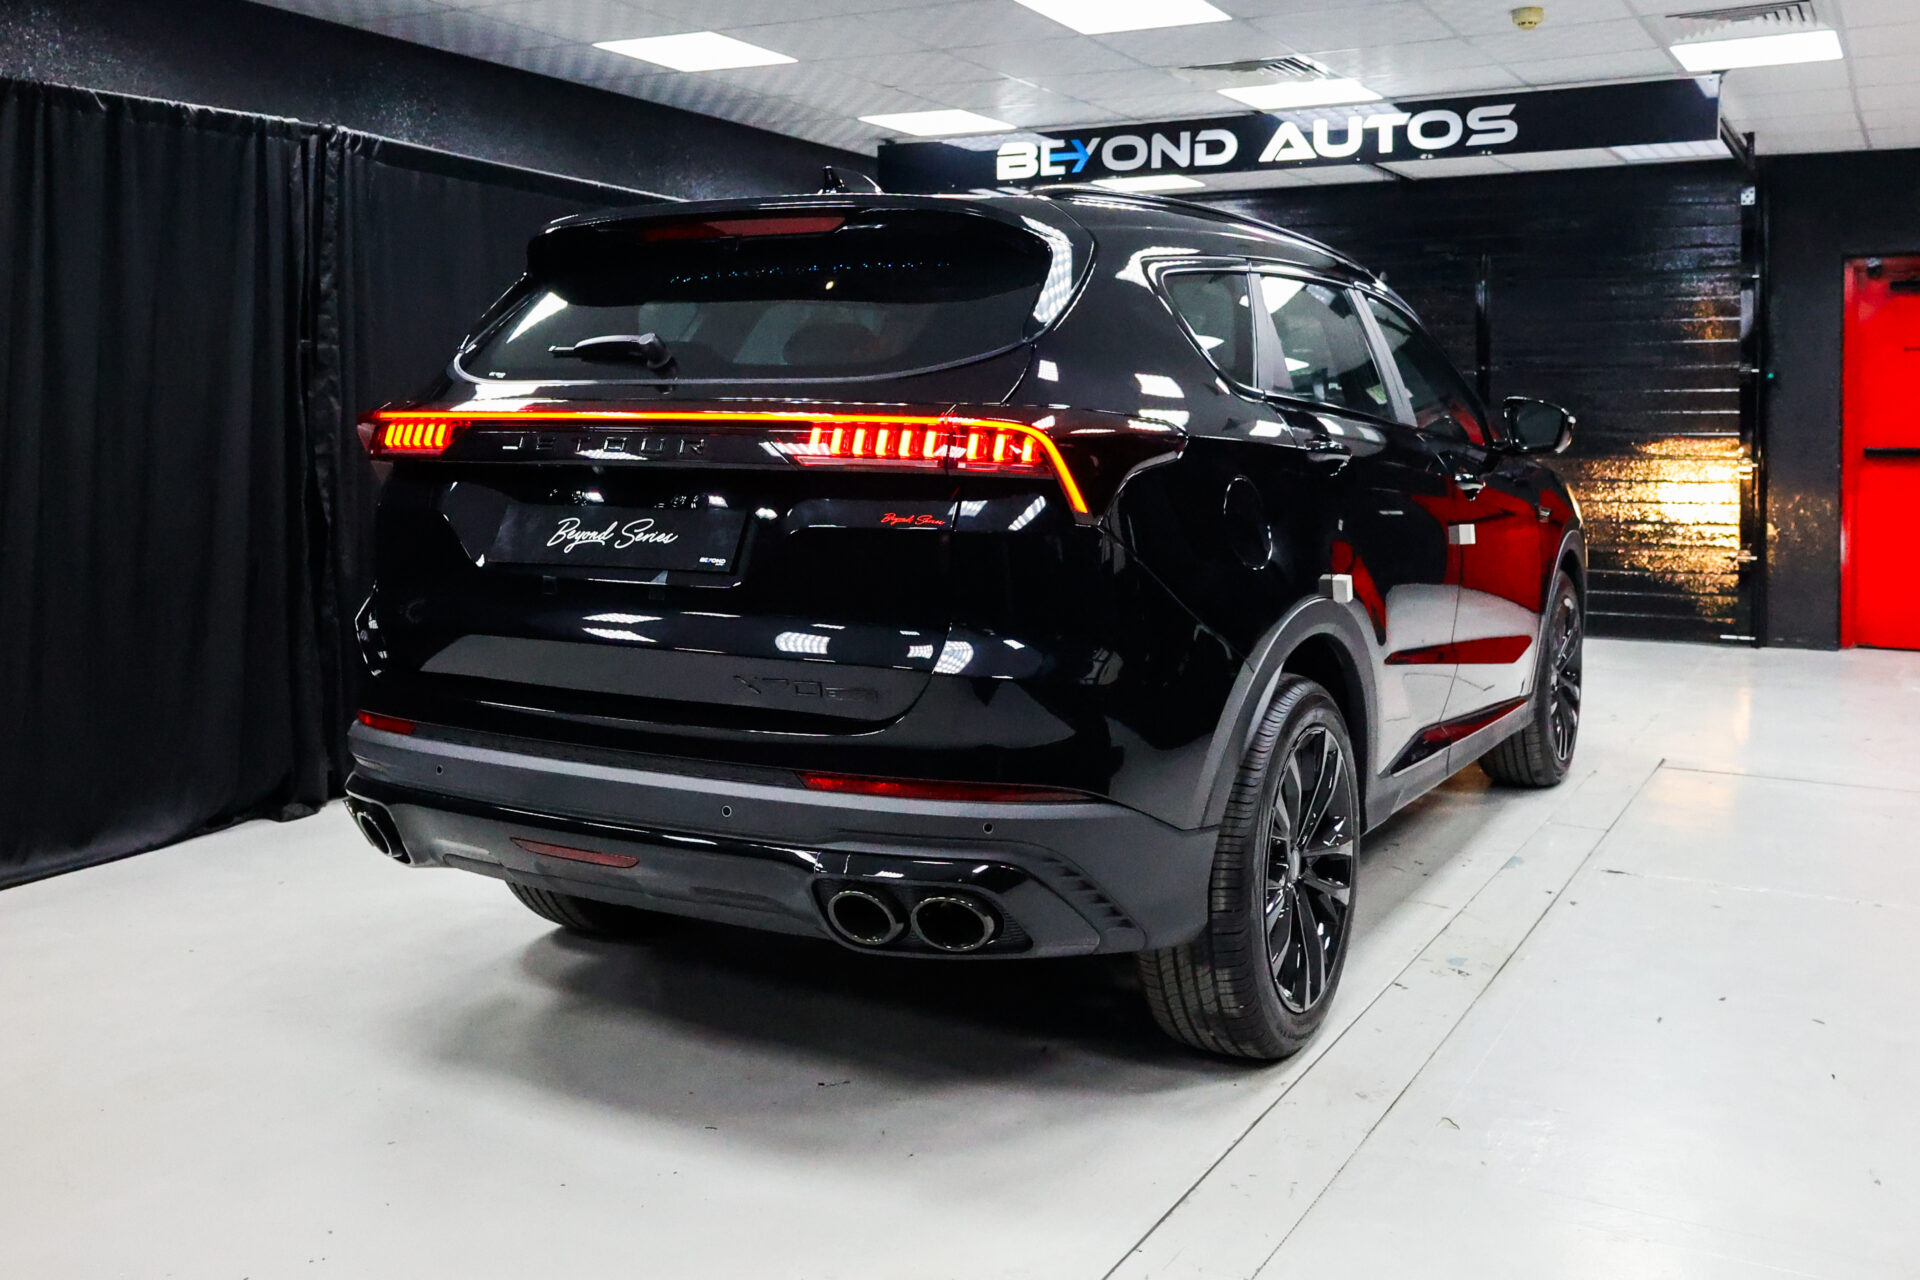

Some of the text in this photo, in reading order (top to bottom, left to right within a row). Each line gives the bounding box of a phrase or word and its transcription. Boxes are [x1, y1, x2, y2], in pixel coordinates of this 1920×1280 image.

[997, 103, 1518, 180] BEYOND AUTOS
[501, 435, 705, 455] JETOUR
[547, 517, 679, 553] Beyond Series
